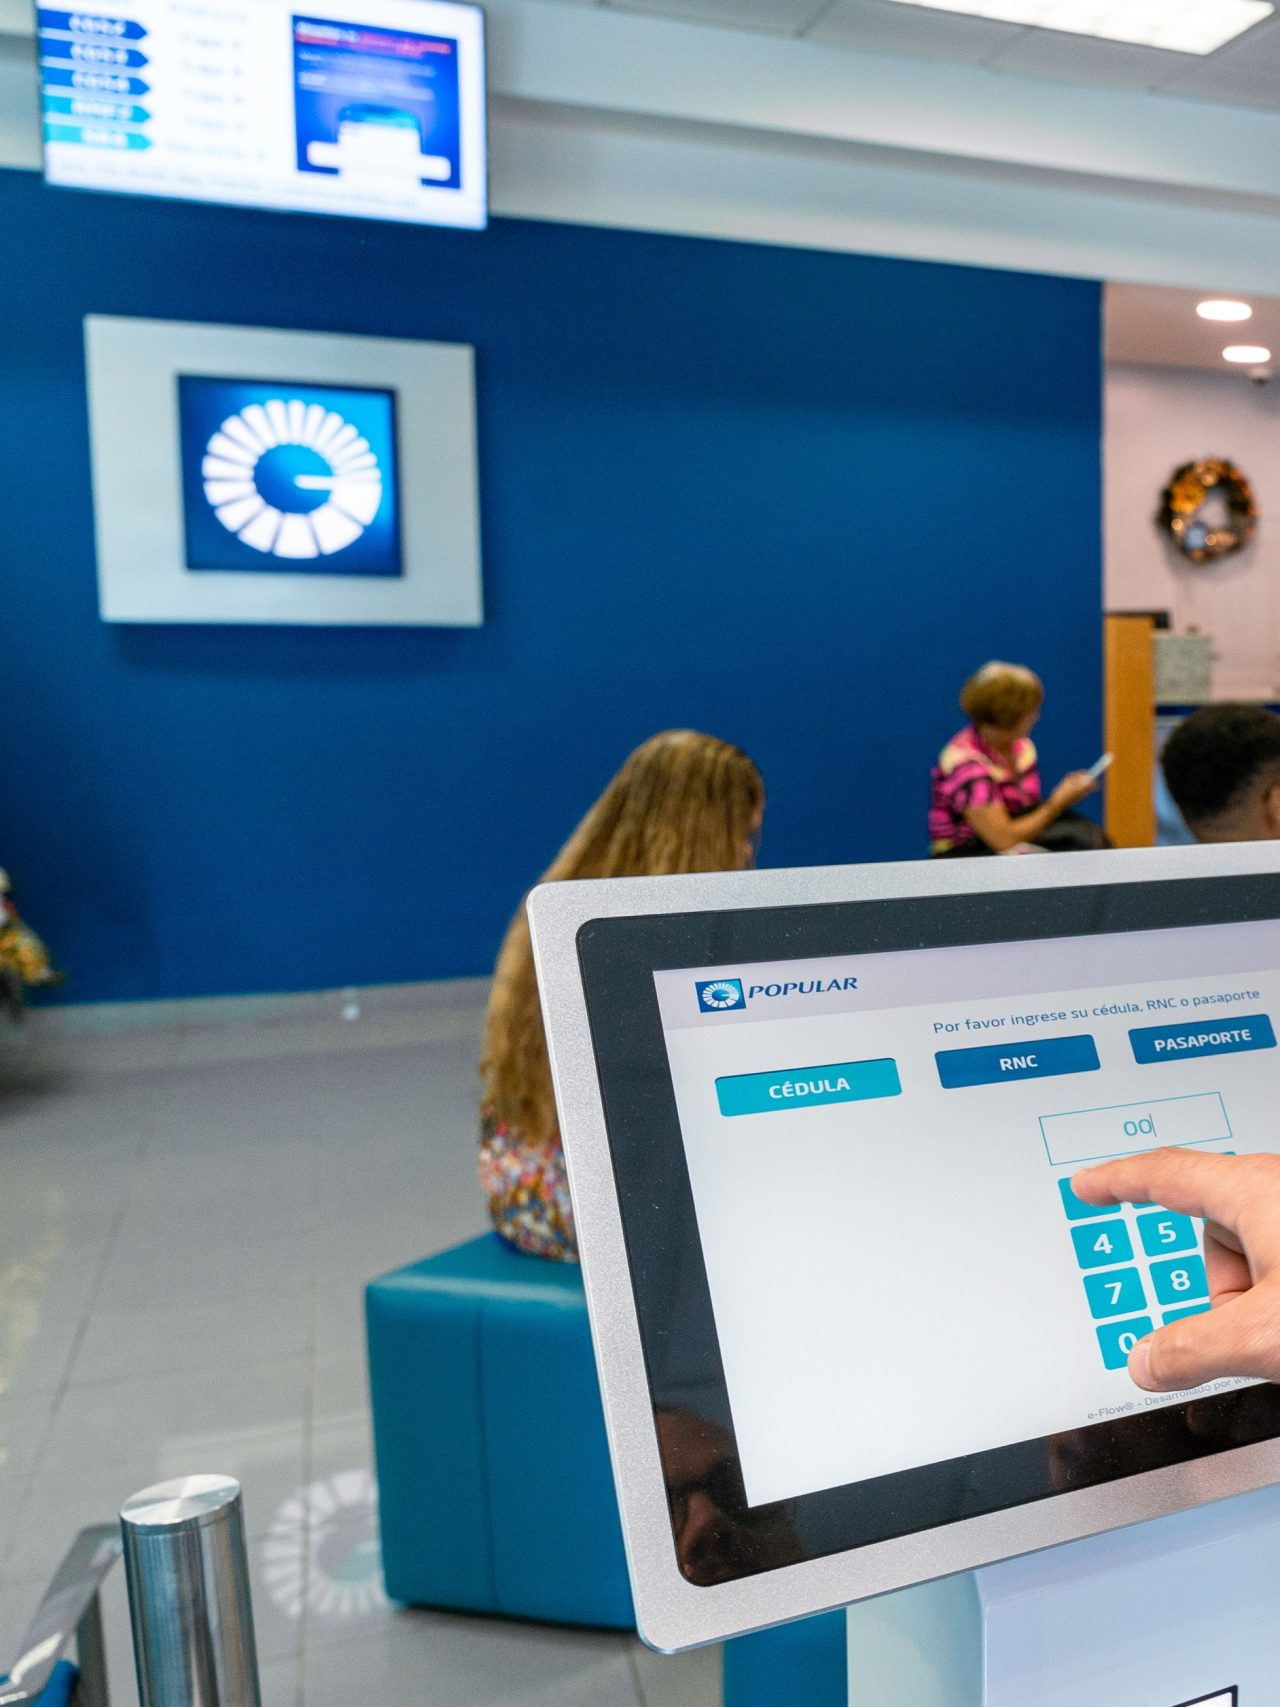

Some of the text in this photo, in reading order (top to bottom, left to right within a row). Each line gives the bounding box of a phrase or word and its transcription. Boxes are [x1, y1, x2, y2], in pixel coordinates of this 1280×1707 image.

[748, 977, 859, 999] POPULAR
[933, 989, 1261, 1034] Por favor ingrese su cédula, RNC o pasaporte
[1154, 1028, 1253, 1052] PASAPORTE
[999, 1054, 1039, 1072] RNC
[768, 1076, 851, 1100] CÉDULA
[1157, 1221, 1177, 1243] 5
[1093, 1233, 1113, 1254] 4
[1169, 1269, 1191, 1291] 8
[1104, 1281, 1123, 1305] 7
[1118, 1332, 1138, 1354] 0
[1214, 1379, 1231, 1392] por
